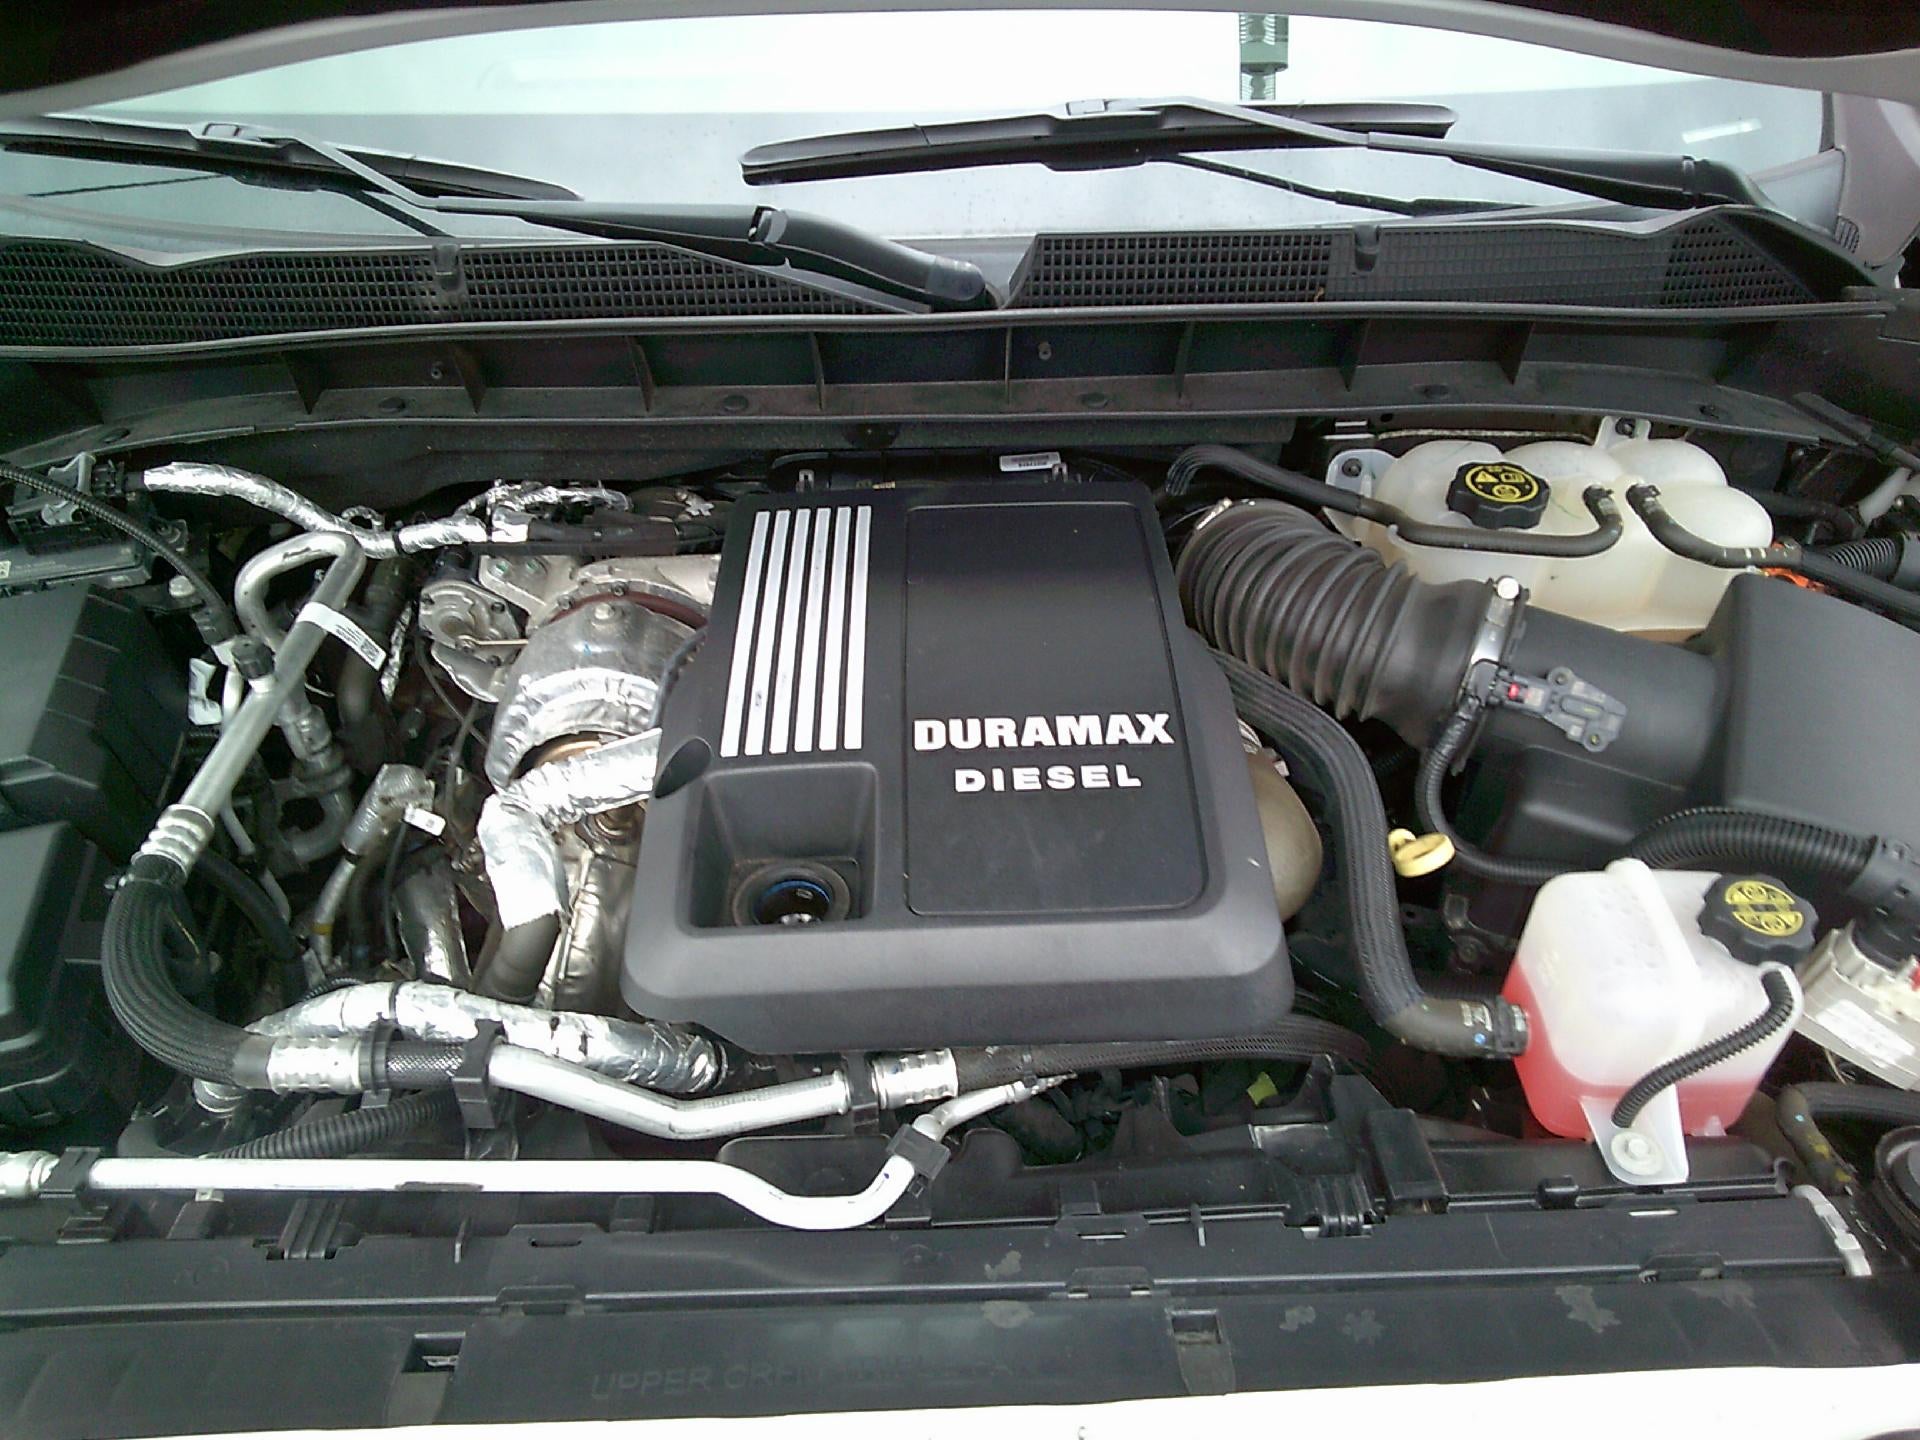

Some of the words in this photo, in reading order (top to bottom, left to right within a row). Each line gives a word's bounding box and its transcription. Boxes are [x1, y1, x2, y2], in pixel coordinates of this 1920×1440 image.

[913, 713, 1175, 750] DURAMAX
[955, 764, 1142, 792] DIESEL
[591, 1367, 711, 1400] UPPER
